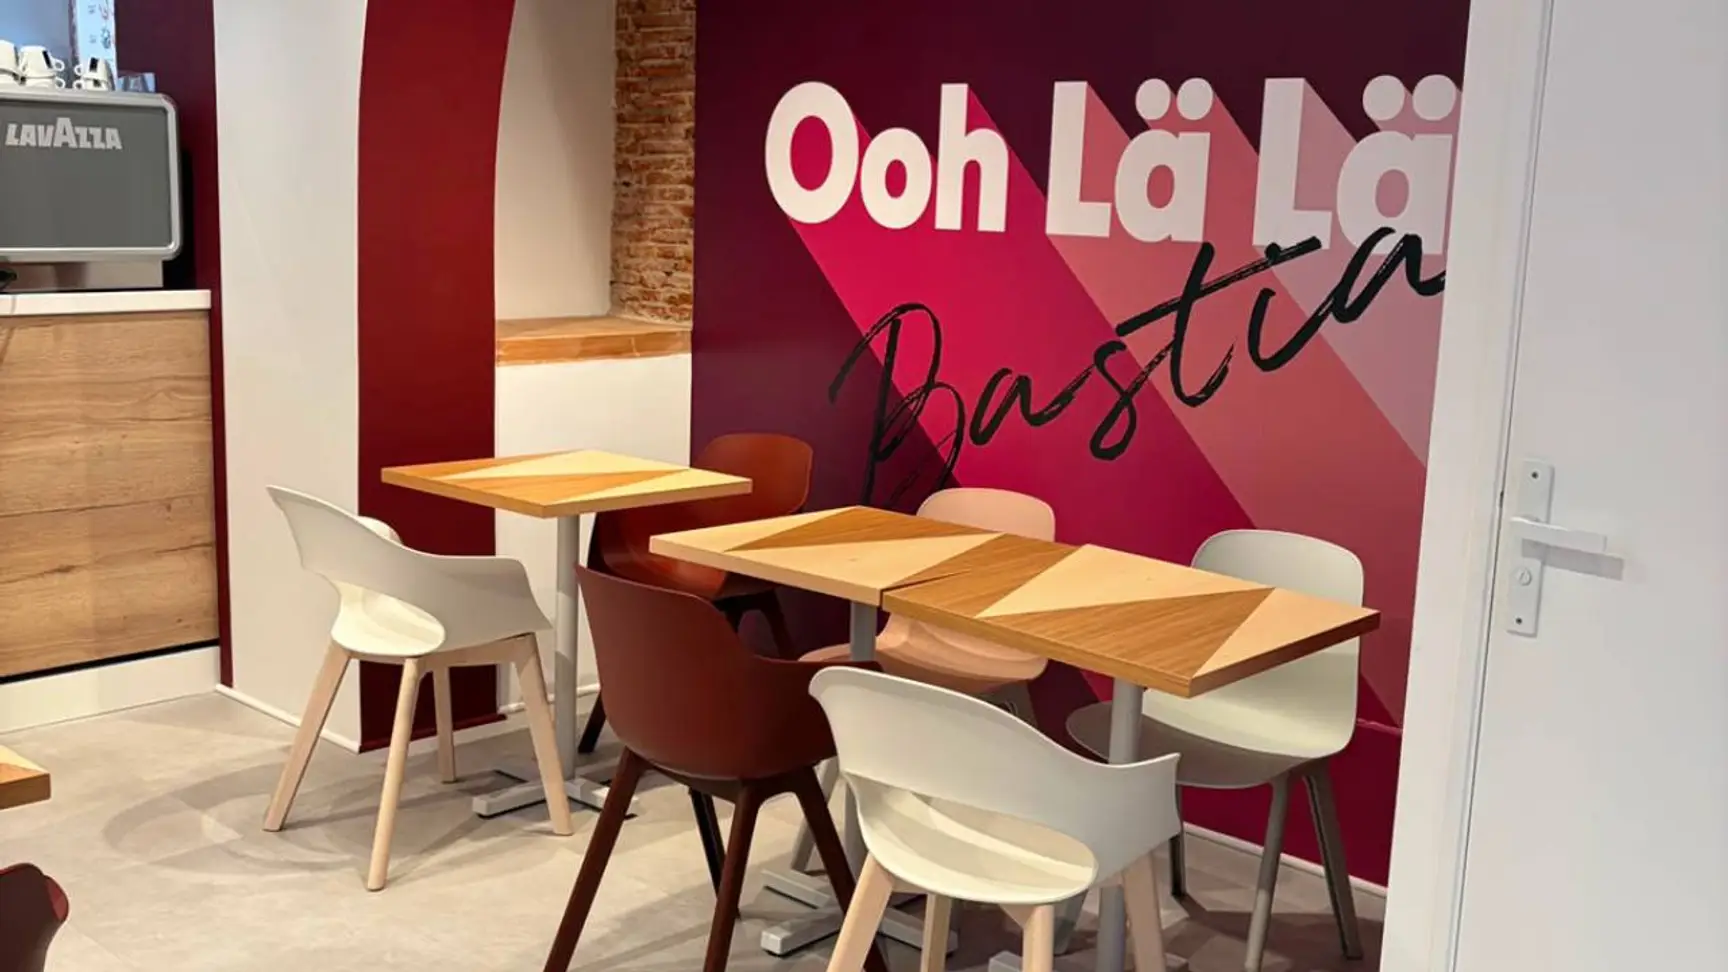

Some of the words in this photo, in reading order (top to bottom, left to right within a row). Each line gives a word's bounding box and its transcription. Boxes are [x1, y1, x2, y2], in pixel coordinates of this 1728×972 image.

[5, 117, 122, 149] LAVAZZA
[765, 81, 1009, 232] Ooh
[1045, 78, 1215, 243] Lä
[1252, 74, 1457, 255] Lä
[828, 227, 1447, 506] Bastia
